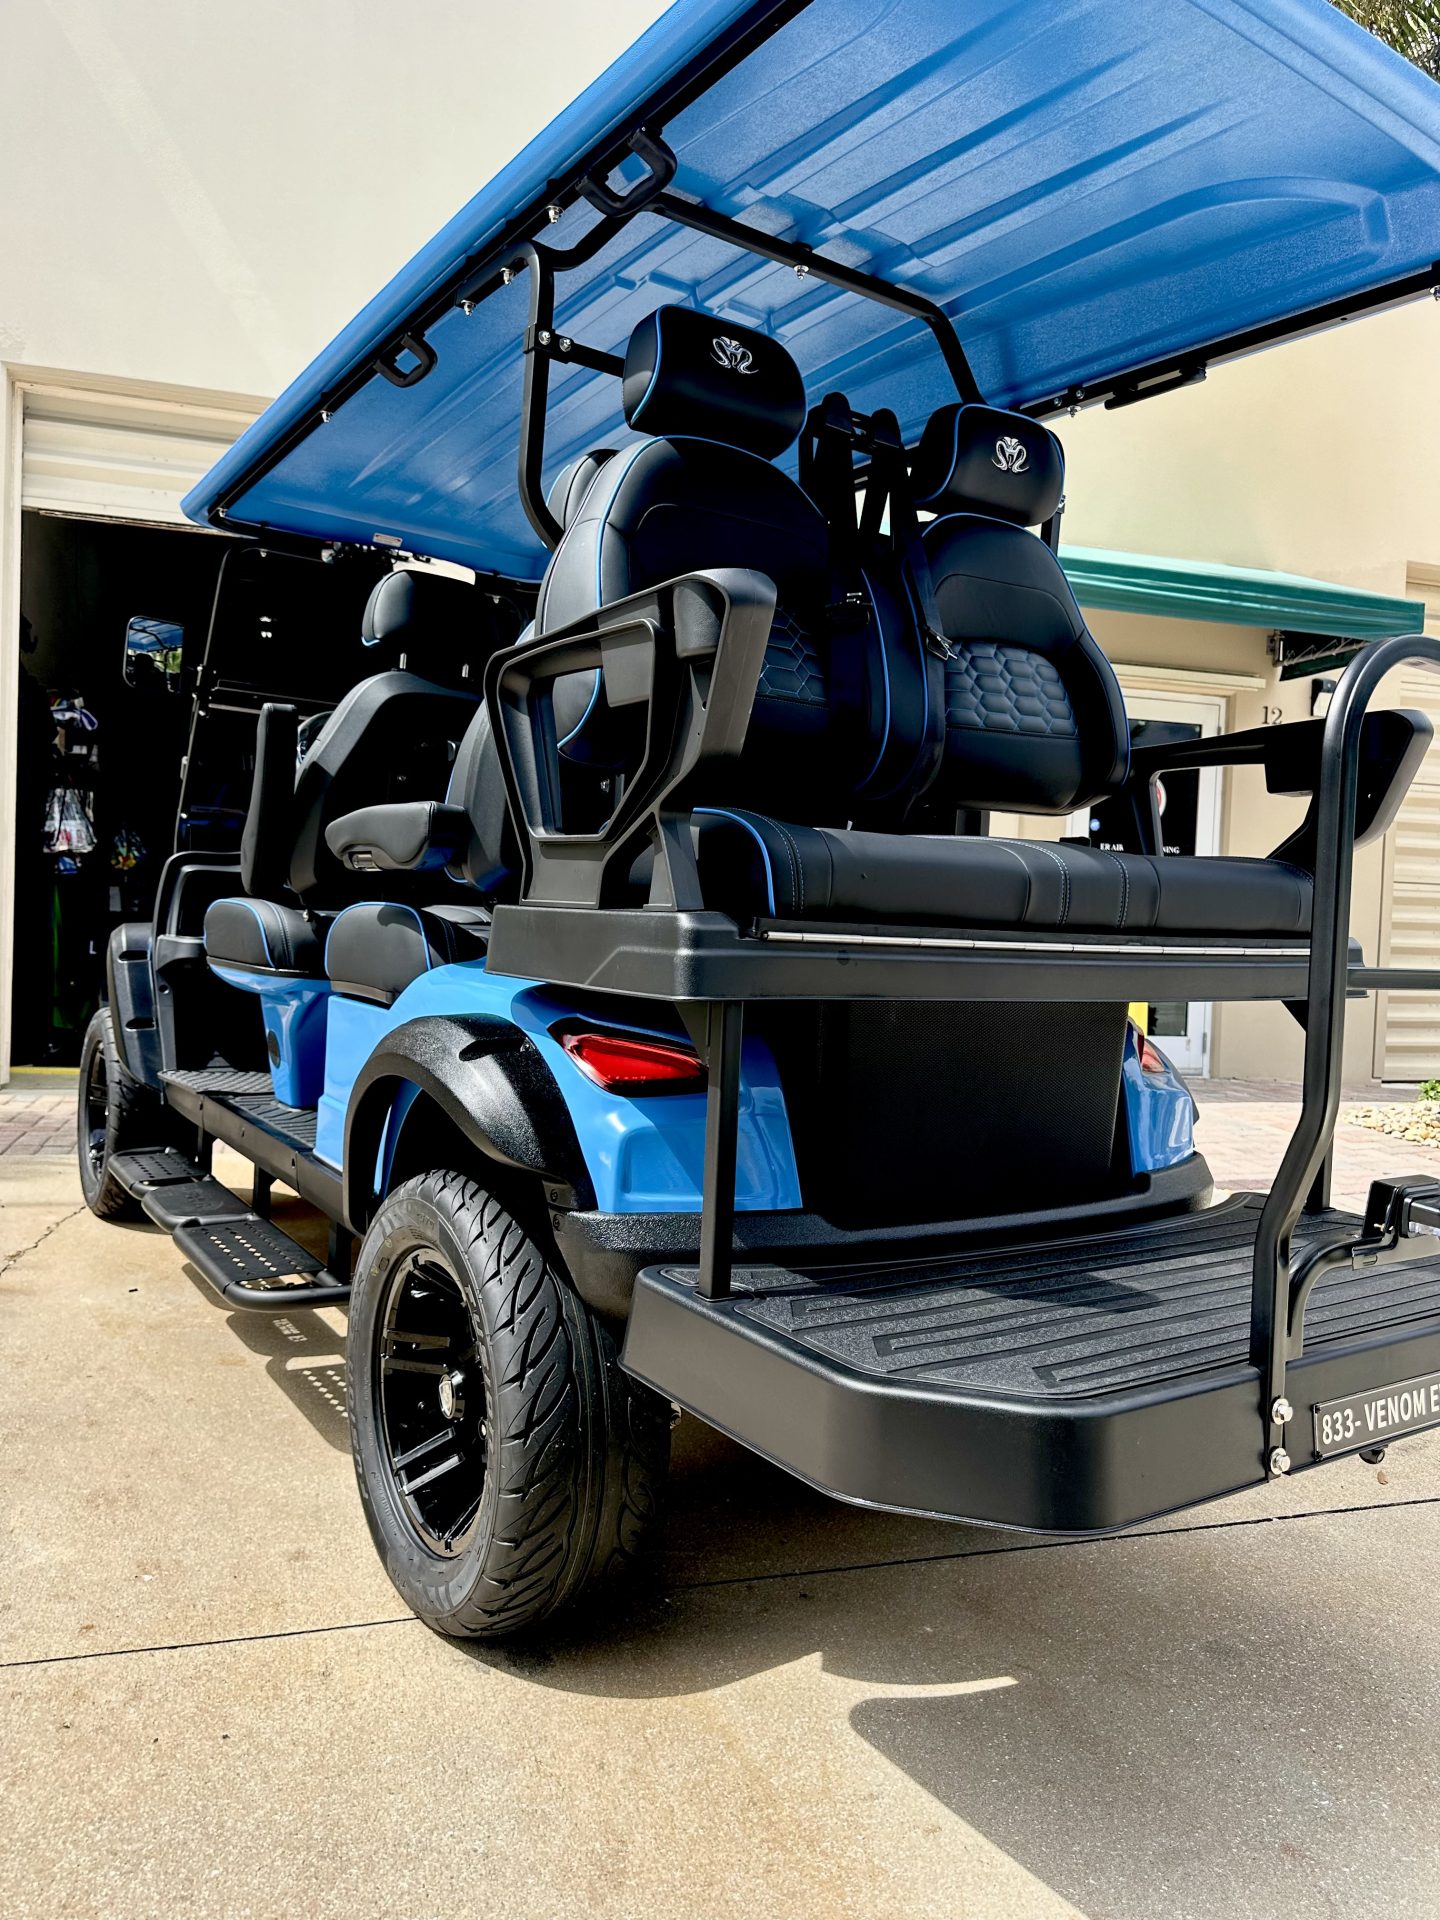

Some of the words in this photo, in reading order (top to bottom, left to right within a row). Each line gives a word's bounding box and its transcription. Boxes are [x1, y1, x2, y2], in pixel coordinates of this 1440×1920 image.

[1261, 705, 1283, 725] 12
[1322, 1408, 1361, 1445] 833-
[1364, 1387, 1426, 1432] VENOM
[1430, 1383, 1440, 1413] E
